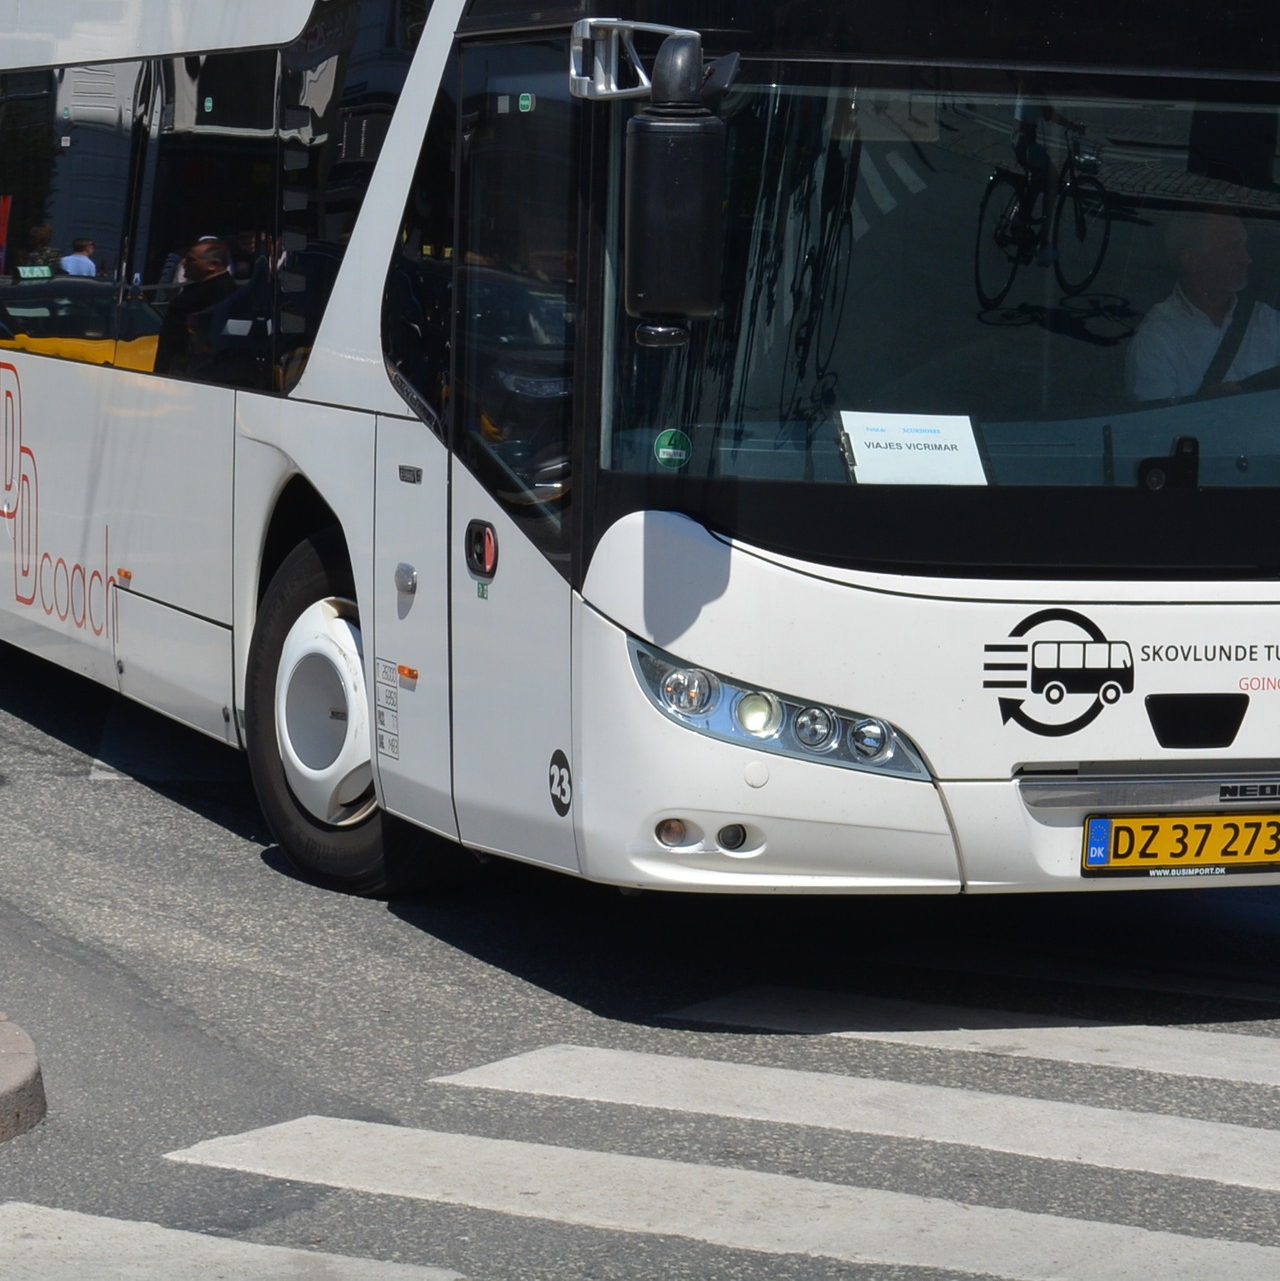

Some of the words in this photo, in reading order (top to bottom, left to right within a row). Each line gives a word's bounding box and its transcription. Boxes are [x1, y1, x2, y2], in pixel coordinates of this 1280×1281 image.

[864, 441, 903, 450] VIAJES
[905, 442, 959, 452] VICRIMAR
[1140, 645, 1258, 662] SKOVLUNDE
[551, 764, 571, 805] 23
[1112, 825, 1160, 860] DZ
[1169, 823, 1213, 858] 37
[1090, 846, 1105, 858] DK
[1149, 867, 1226, 877] WWW.BUSIMPORT.DK
